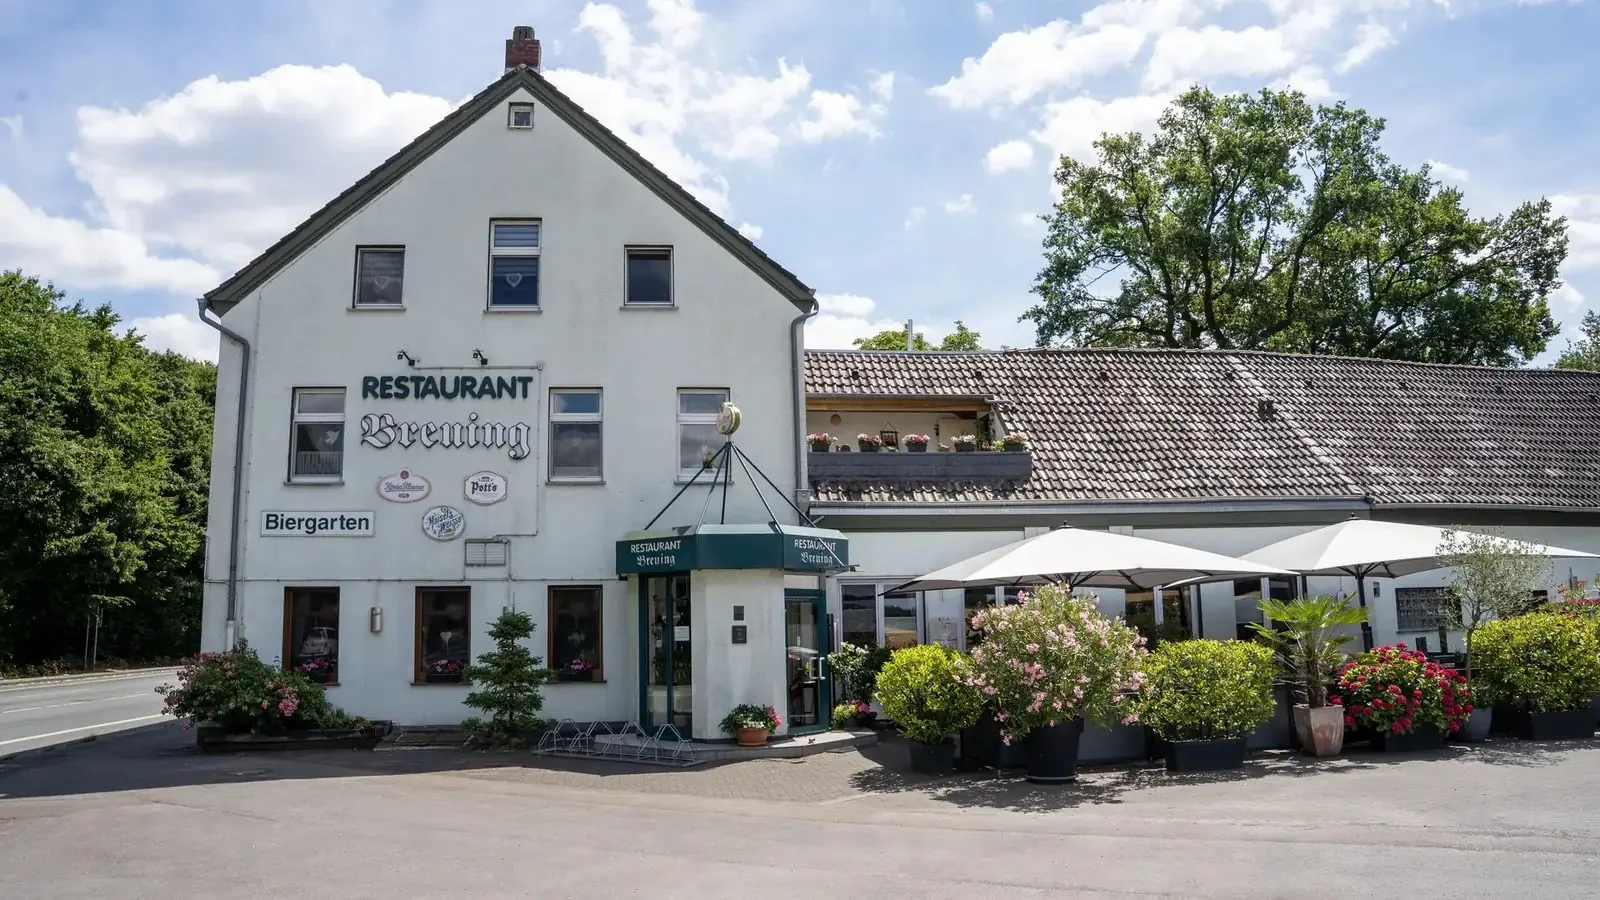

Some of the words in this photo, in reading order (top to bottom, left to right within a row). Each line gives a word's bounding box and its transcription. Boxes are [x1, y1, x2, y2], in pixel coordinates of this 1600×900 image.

[362, 376, 533, 399] RESTAURANT
[360, 412, 531, 460] Breuing
[266, 513, 369, 534] Biergarten
[630, 540, 682, 553] RESTAURANT
[636, 553, 676, 567] Breuing
